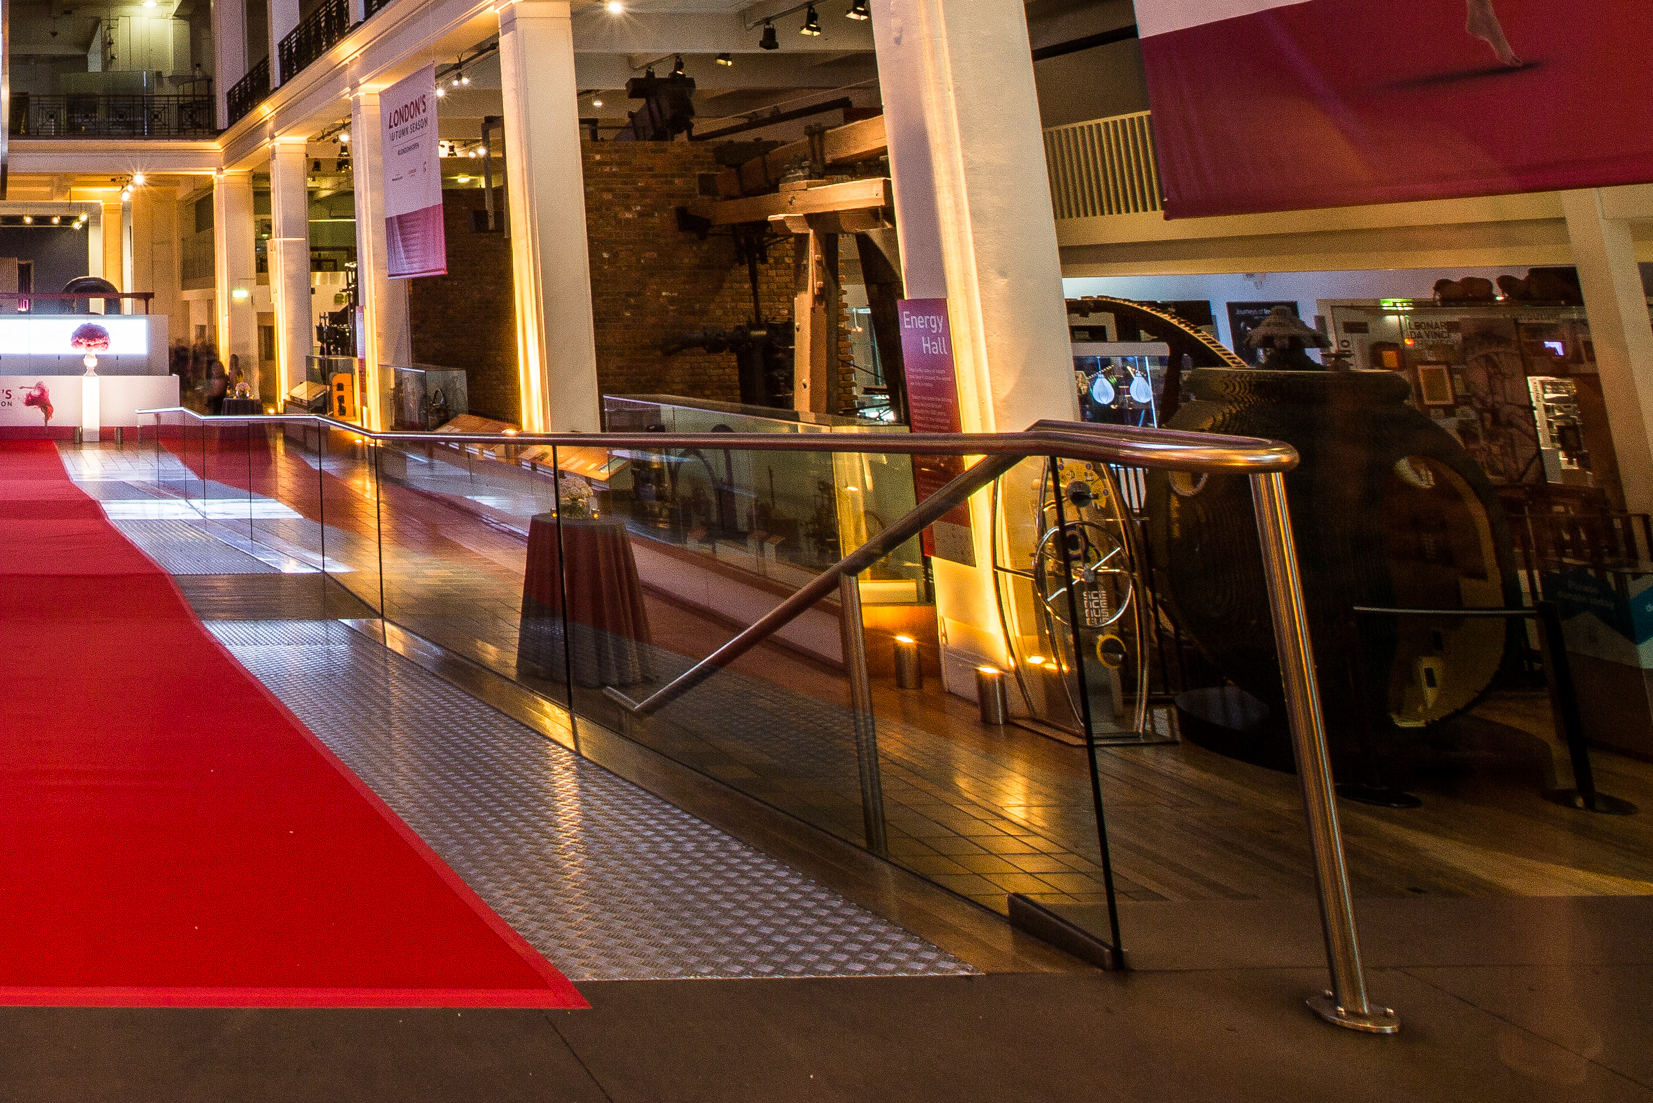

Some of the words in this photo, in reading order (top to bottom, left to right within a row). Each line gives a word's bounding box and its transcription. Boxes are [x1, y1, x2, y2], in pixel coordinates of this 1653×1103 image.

[388, 94, 427, 130] LONDON'S
[410, 116, 429, 134] SEASON
[903, 311, 943, 333] Energy
[921, 337, 948, 355] Hall
